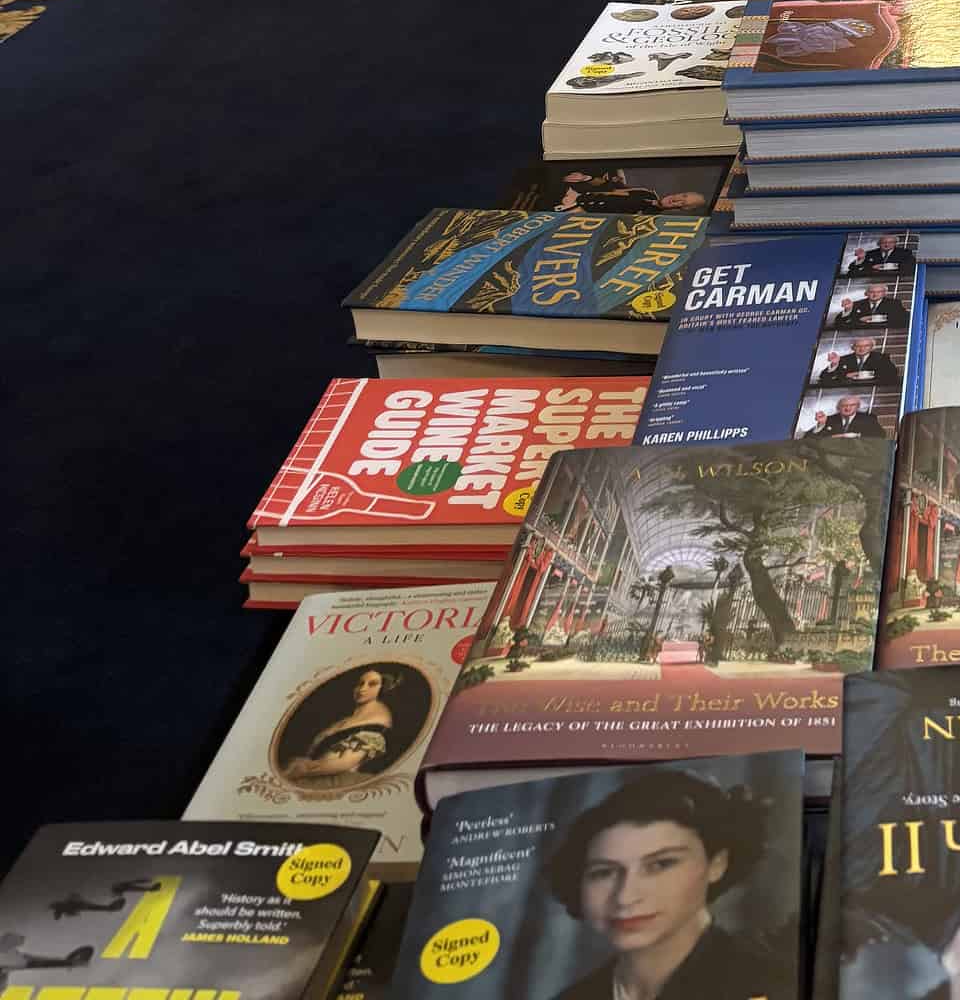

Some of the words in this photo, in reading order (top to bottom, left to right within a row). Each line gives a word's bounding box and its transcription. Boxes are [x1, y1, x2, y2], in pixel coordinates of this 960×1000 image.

[602, 33, 628, 45] &
[530, 215, 606, 307] RIVERS
[600, 218, 705, 297] THREE
[692, 264, 752, 288] GET
[684, 280, 818, 312] CARMAN
[587, 386, 648, 439] THE
[348, 389, 435, 477] GUIDE
[410, 388, 488, 464] WINE
[642, 432, 683, 446] KAREN
[687, 427, 748, 441] PHILLIPPS
[448, 388, 541, 509] MARKET
[697, 459, 808, 479] WILSON
[514, 490, 534, 512] Copy
[307, 606, 479, 636] VICTORI
[363, 637, 372, 645] A
[382, 633, 424, 644] LIFE
[911, 644, 960, 663] The
[609, 695, 658, 713] and
[672, 693, 744, 713] Their
[753, 690, 839, 710] Works
[469, 722, 499, 734] THE
[503, 721, 562, 733] LEGACY
[568, 720, 590, 731] OF
[594, 720, 624, 731] THE
[630, 720, 680, 730] GREAT
[684, 718, 778, 730] EXHIBITION
[782, 718, 801, 728] OF
[807, 716, 837, 727] 1851
[902, 793, 948, 808] Story.
[452, 830, 501, 845] ANDREW
[505, 822, 556, 836] ROBERTS
[62, 841, 167, 856] Edward
[169, 840, 233, 856] Abel
[878, 821, 926, 876] II
[289, 857, 344, 873] Signed
[442, 869, 482, 881] SIMON
[484, 863, 521, 876] SEBAG
[290, 872, 333, 886] Copy
[440, 874, 518, 892] MONTEFIORE
[267, 896, 282, 905] as
[195, 907, 238, 918] should
[240, 907, 255, 918] be
[198, 920, 252, 932] Superbly
[182, 933, 224, 944] JAMES
[226, 934, 290, 945] HOLLAND
[432, 930, 490, 952] Signed
[435, 951, 481, 968] Copy
